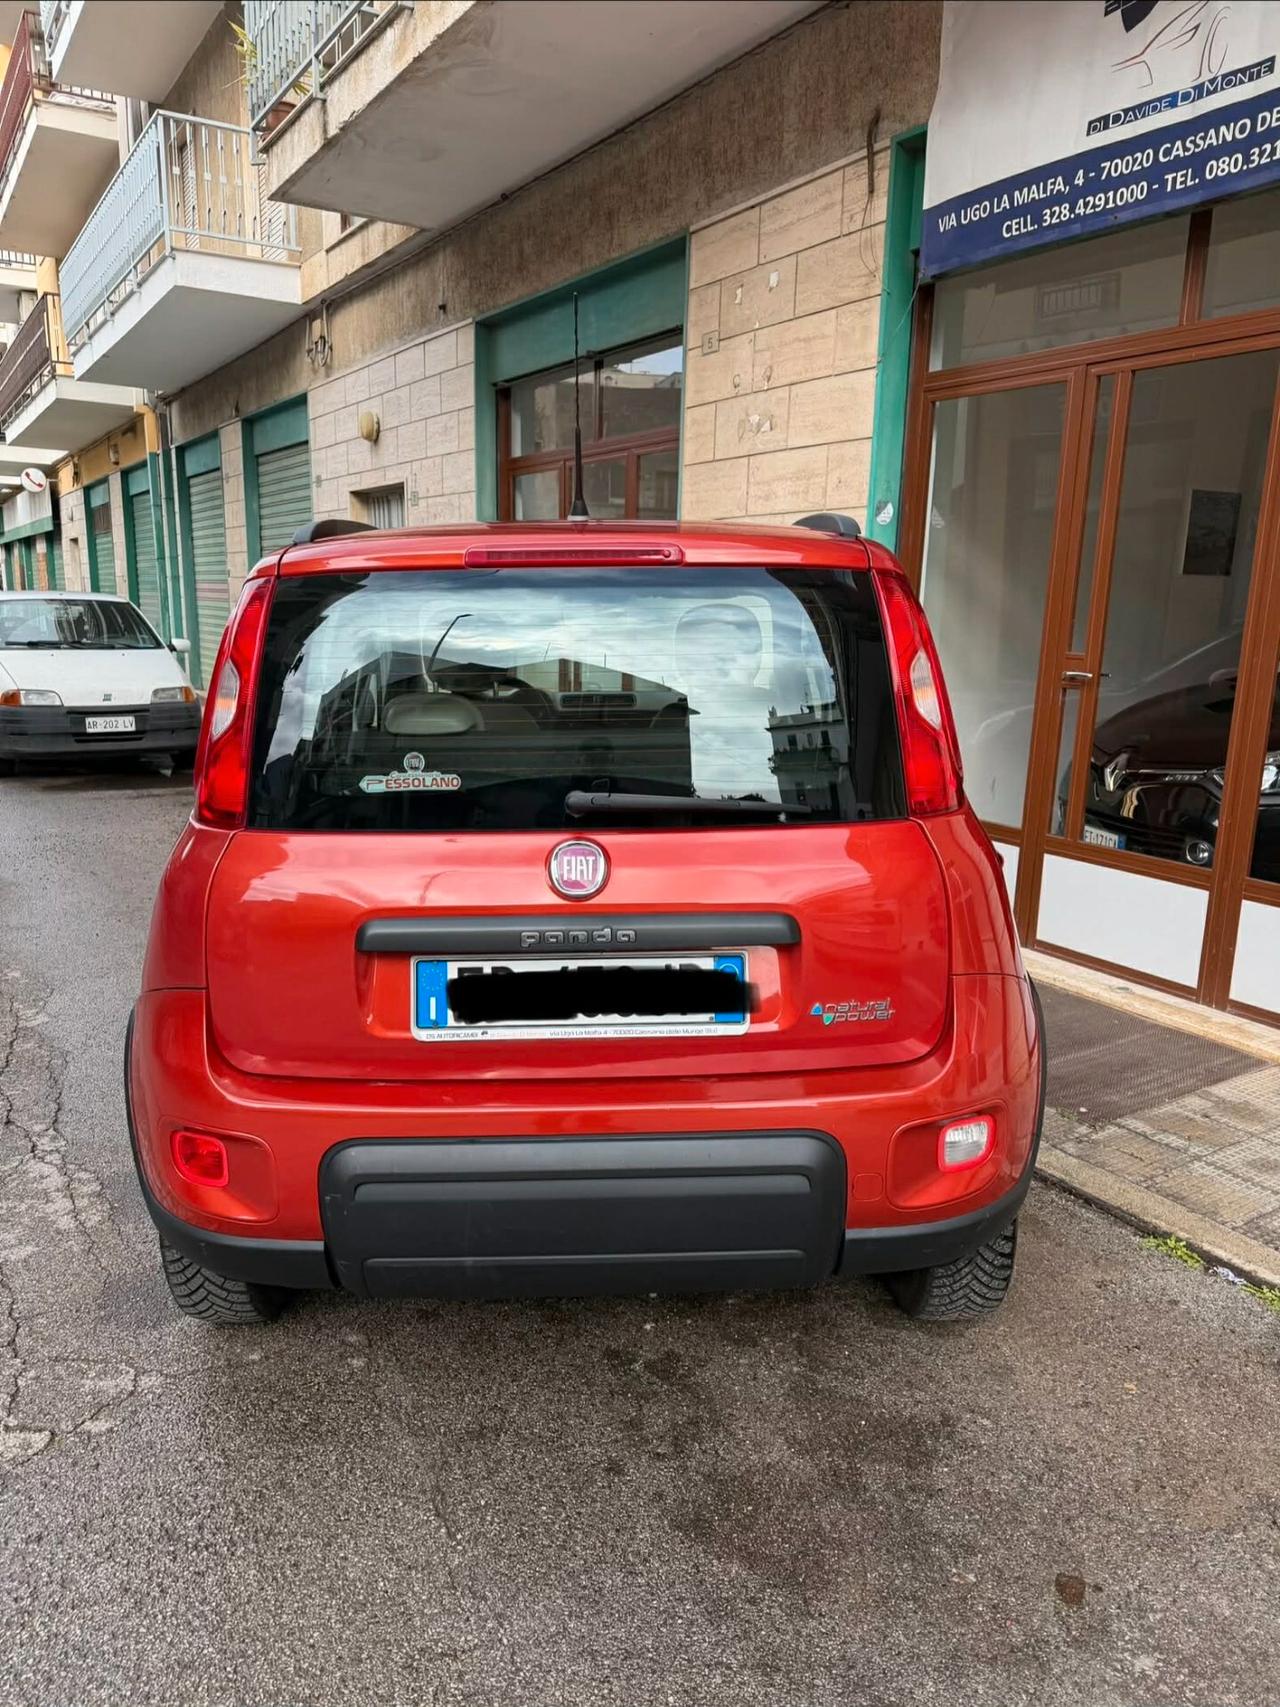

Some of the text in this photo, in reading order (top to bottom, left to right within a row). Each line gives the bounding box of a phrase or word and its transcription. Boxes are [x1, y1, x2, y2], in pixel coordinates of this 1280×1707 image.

[1089, 121, 1103, 135] DI
[938, 215, 957, 233] VIA
[961, 201, 990, 225] UGO
[994, 197, 1010, 213] LA
[1014, 176, 1070, 207] MALFA,
[1074, 169, 1084, 187] 4
[1100, 149, 1153, 180] 70020
[1158, 118, 1251, 163] CASSANO
[1002, 215, 1038, 238] CELL.
[1041, 181, 1148, 227] 328.4291000
[1164, 168, 1199, 193] TEL.
[102, 720, 119, 730] 202
[123, 719, 134, 729] LV
[366, 776, 461, 790] PESSOLANO
[563, 855, 596, 881] FIAT
[520, 927, 636, 948] panda
[825, 997, 891, 1012] natural
[834, 1009, 896, 1024] power
